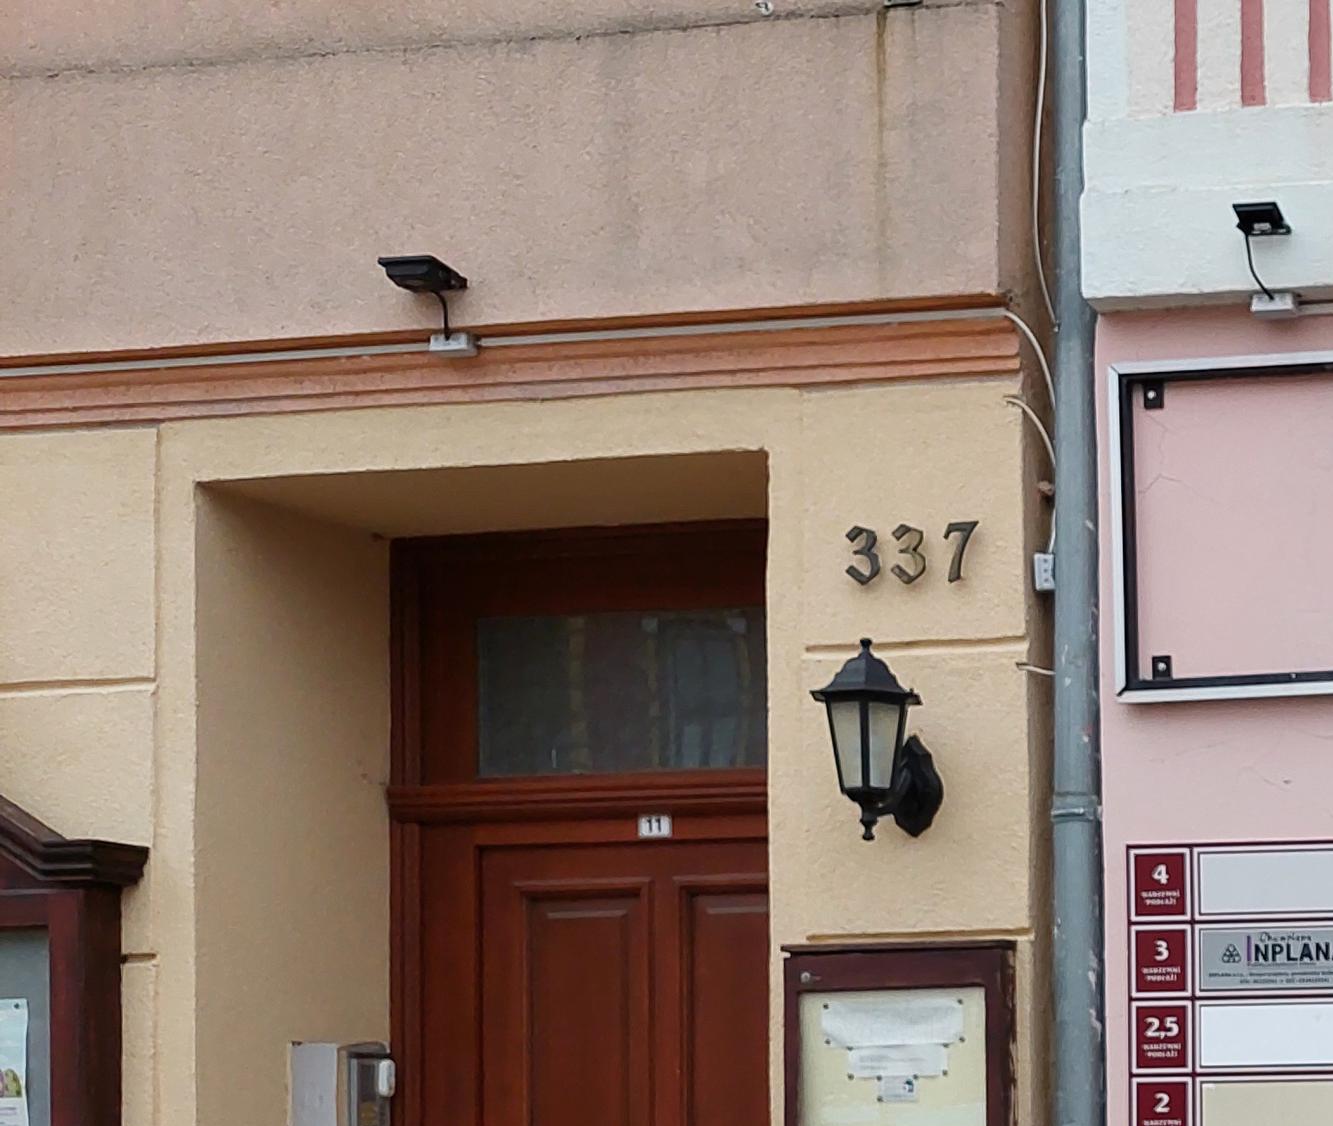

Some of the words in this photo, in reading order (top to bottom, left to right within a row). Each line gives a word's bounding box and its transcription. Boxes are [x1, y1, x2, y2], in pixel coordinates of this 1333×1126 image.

[845, 520, 980, 586] 337
[646, 816, 662, 833] 11
[1151, 864, 1170, 885] 4
[1153, 940, 1170, 961] 3
[1143, 1016, 1180, 1039] 2,5
[1153, 1092, 1171, 1113] 2
